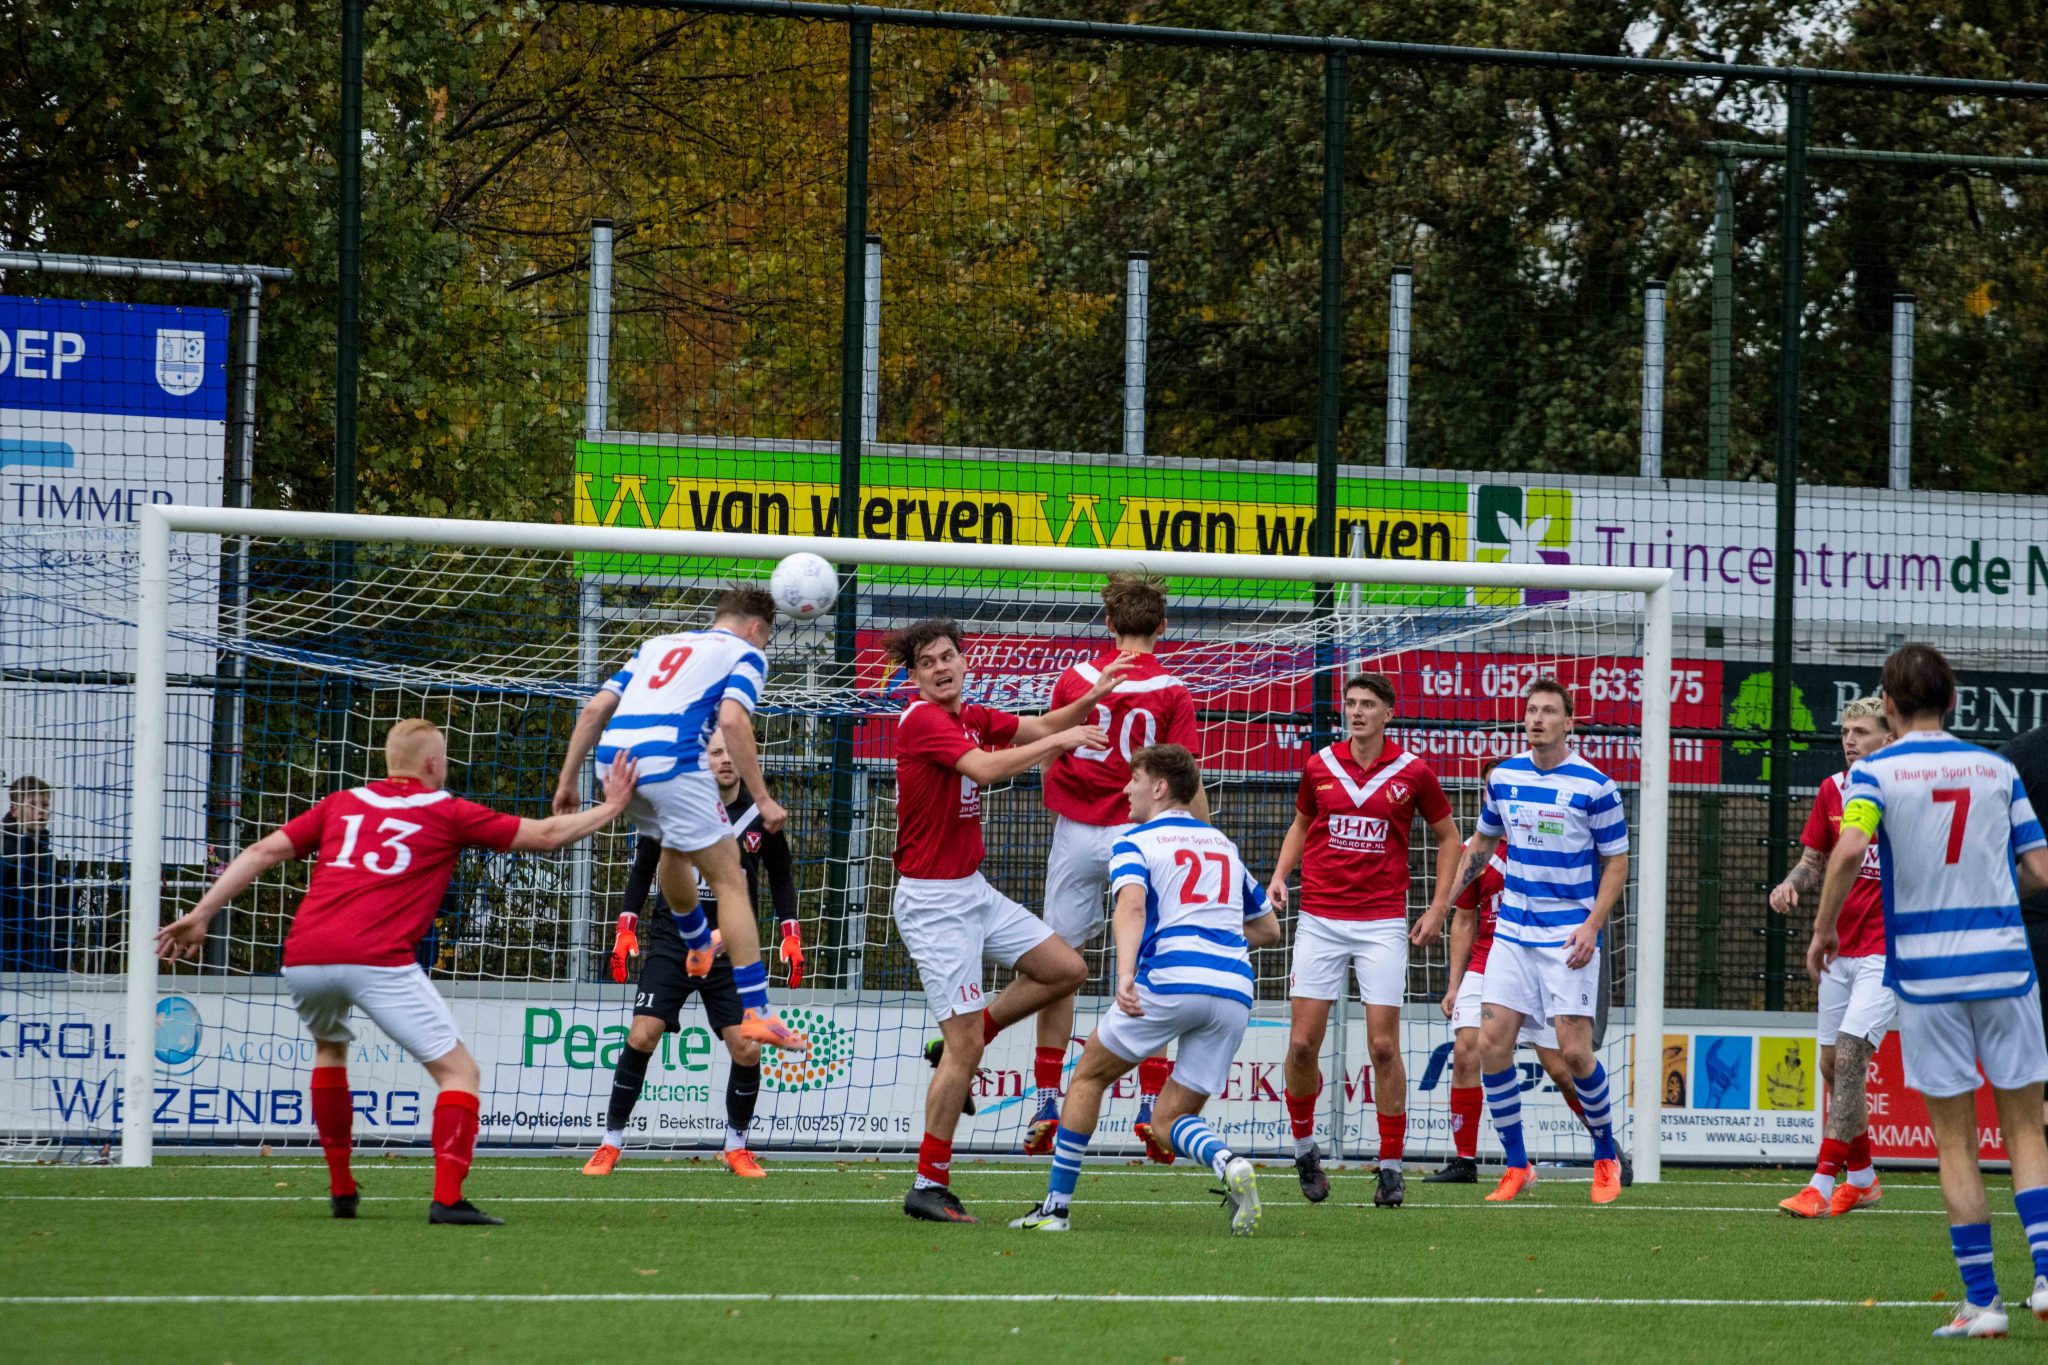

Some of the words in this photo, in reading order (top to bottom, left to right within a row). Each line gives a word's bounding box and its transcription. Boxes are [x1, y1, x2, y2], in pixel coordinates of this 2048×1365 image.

[0, 328, 86, 380] EP
[689, 489, 789, 535] van
[811, 494, 1013, 545] werven
[1140, 508, 1236, 554] van
[1595, 525, 1942, 592] Tuincentrum
[1950, 539, 2012, 595] de
[648, 646, 693, 689] 9
[1420, 662, 1471, 696] tel.
[1589, 667, 1704, 704] 63375
[1073, 703, 1156, 763] 20
[1894, 768, 1938, 781] Elburger
[1942, 766, 1972, 780] Sport
[1976, 764, 1998, 779] Club
[325, 814, 423, 875] 13
[1331, 817, 1386, 839] JHM
[1932, 787, 1971, 865] 7
[1174, 848, 1231, 905] 27
[636, 992, 654, 1009] 21
[959, 982, 981, 1002] 18
[221, 1041, 424, 1064] ACCOUANT
[524, 1006, 711, 1072] Peale
[52, 1078, 420, 1127] WZENBRG
[637, 1079, 710, 1103] ticiens
[970, 1069, 1023, 1098] an
[515, 1111, 592, 1130] Opticiens
[769, 1116, 793, 1132] Tel.
[797, 1116, 844, 1134] (0525)
[849, 1117, 866, 1132] 72
[870, 1117, 888, 1132] 90
[894, 1118, 910, 1133] 15
[1676, 1132, 1687, 1142] 15
[1706, 1132, 1815, 1145] WWW.AGJ-ELBURG.NL
[1753, 1116, 1765, 1127] 21
[1776, 1116, 1815, 1128] ELBURG
